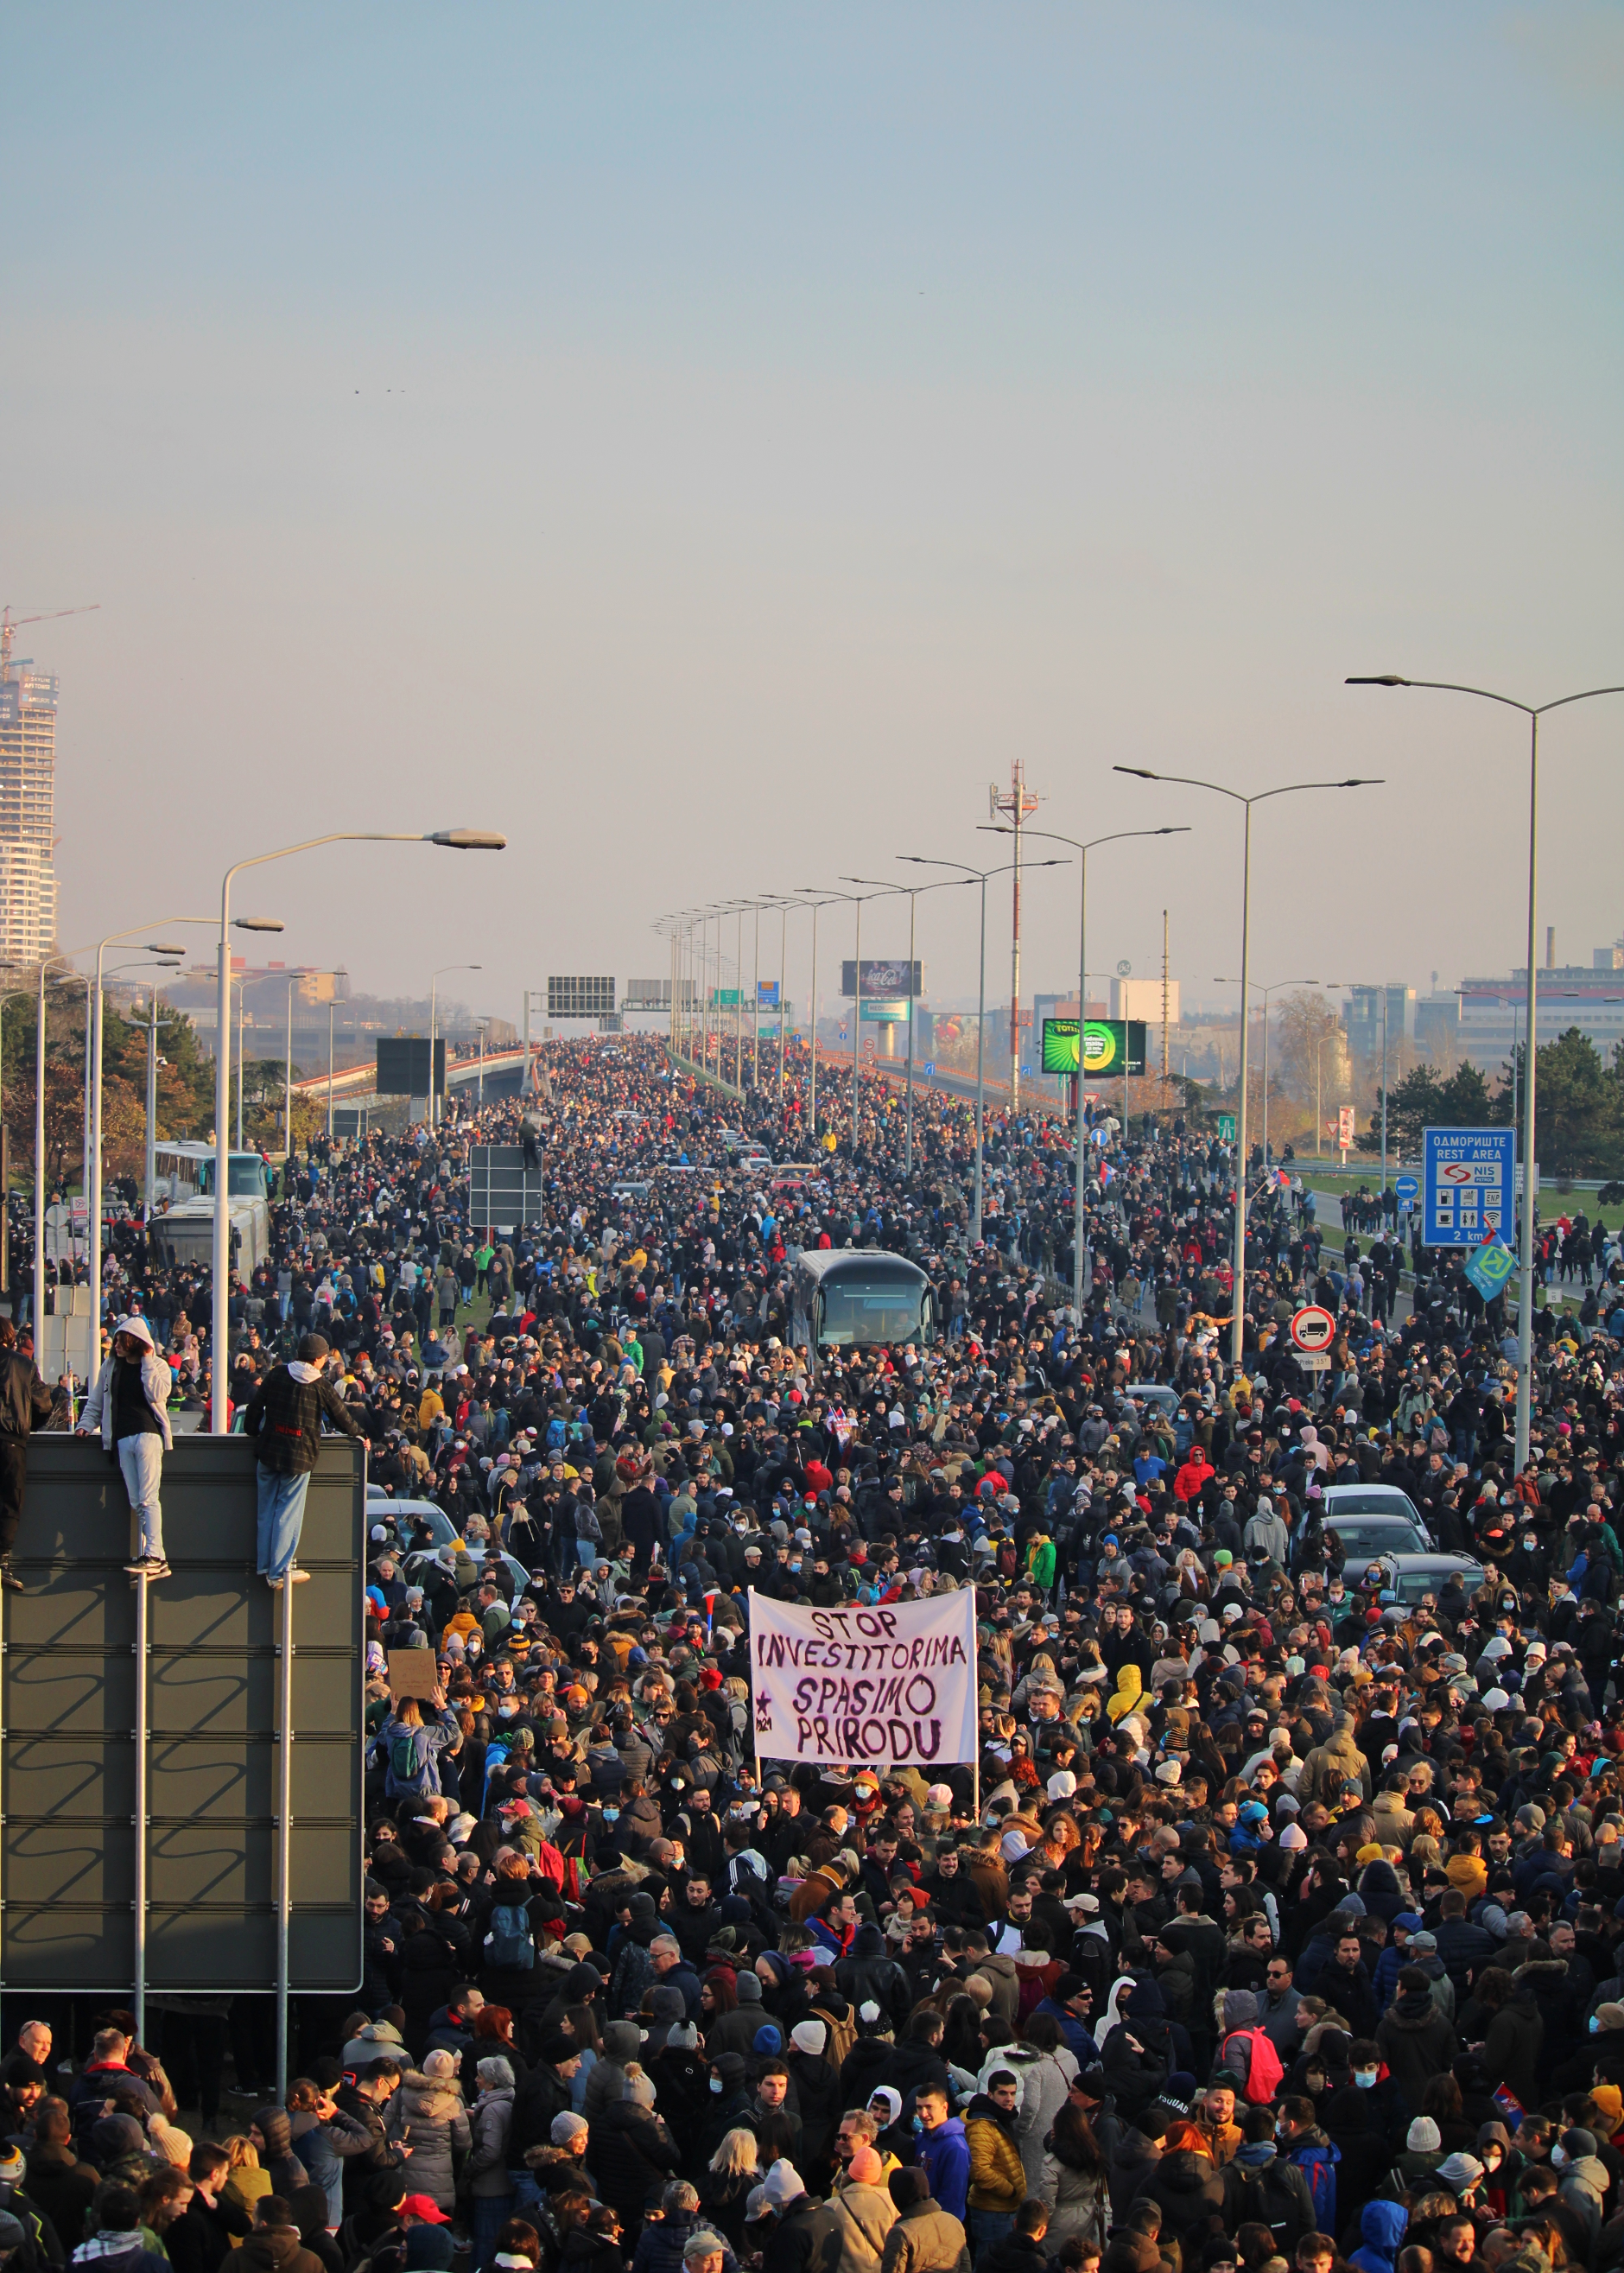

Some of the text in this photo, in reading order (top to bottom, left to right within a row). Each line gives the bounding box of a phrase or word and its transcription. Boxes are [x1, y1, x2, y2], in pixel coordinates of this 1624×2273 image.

[1434, 1136, 1507, 1147] ОДМОРИШТЕ
[1437, 1149, 1501, 1159] REST AREA
[1474, 1165, 1495, 1176] NIS
[1486, 1194, 1500, 1203] ENP
[1454, 1230, 1483, 1241] 2 km
[811, 1610, 898, 1640] STOP
[758, 1635, 967, 1670] INVESTITORIMA
[793, 1673, 936, 1716] SPASIMO
[797, 1717, 942, 1761] PRIRODU
